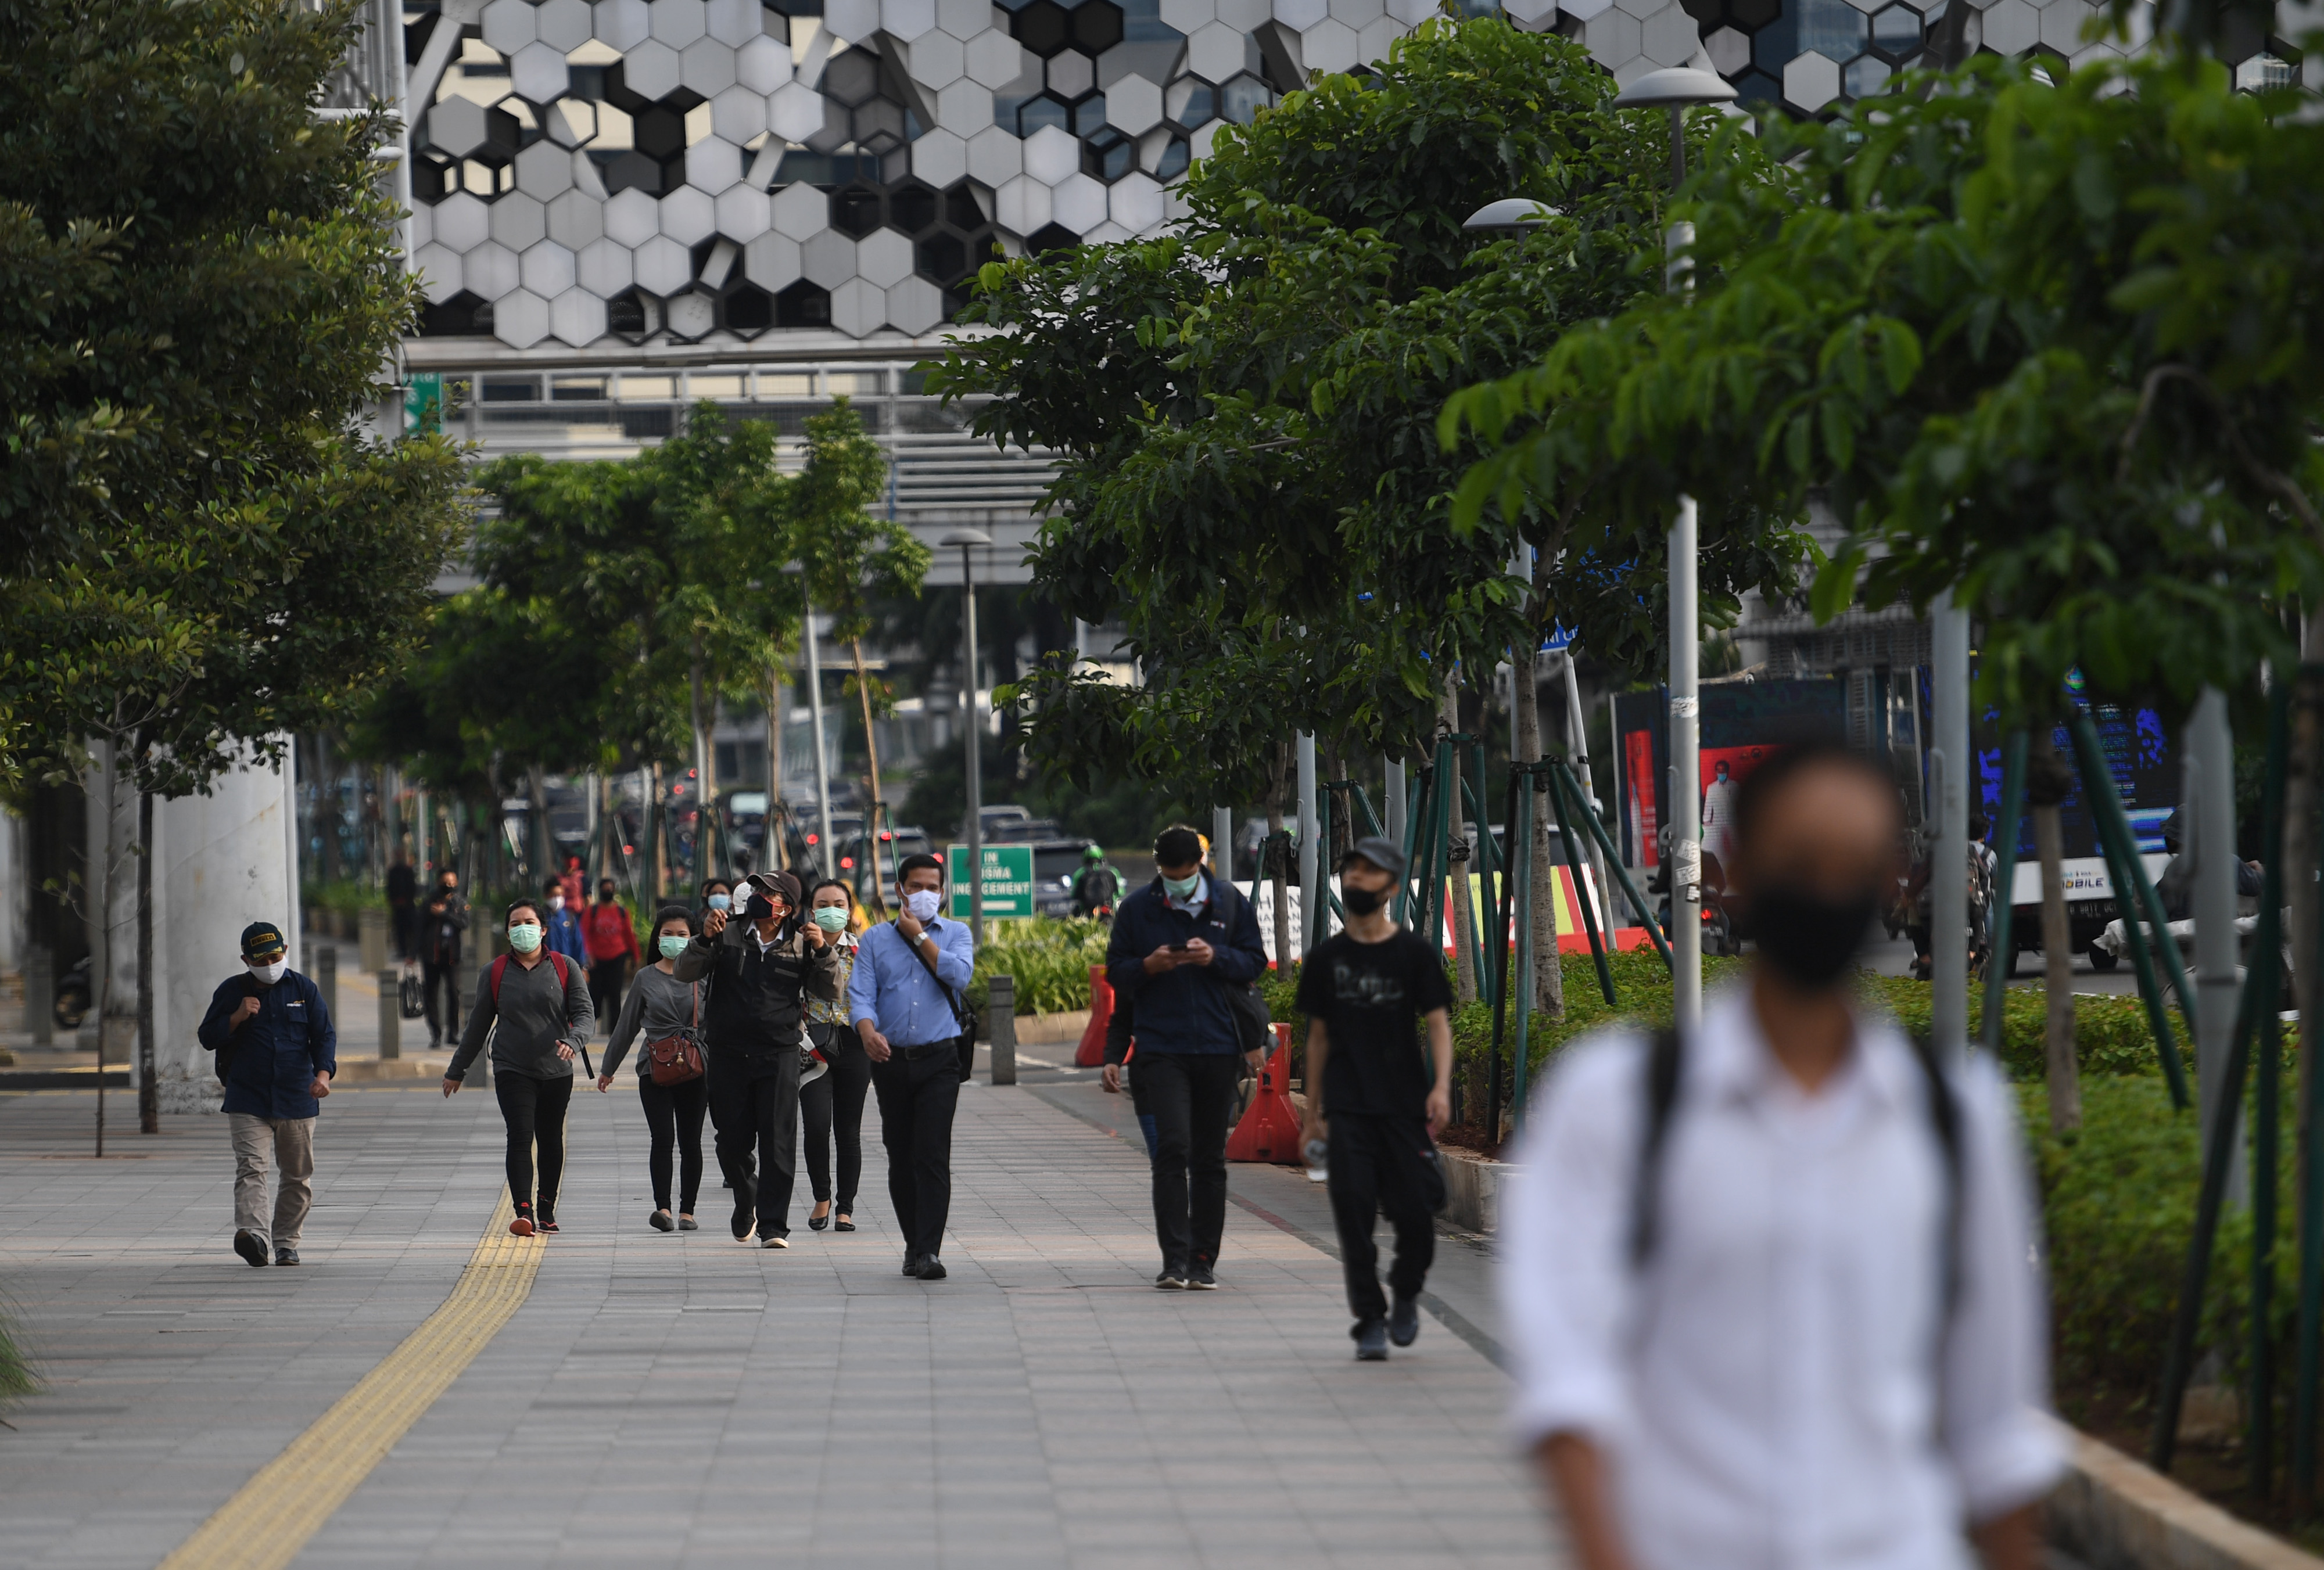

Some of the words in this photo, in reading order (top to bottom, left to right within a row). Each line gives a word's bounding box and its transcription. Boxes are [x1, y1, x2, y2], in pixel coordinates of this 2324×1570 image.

[984, 851, 998, 863] IN
[981, 866, 1012, 879] ISMA
[953, 882, 1030, 895] INDCEMENT
